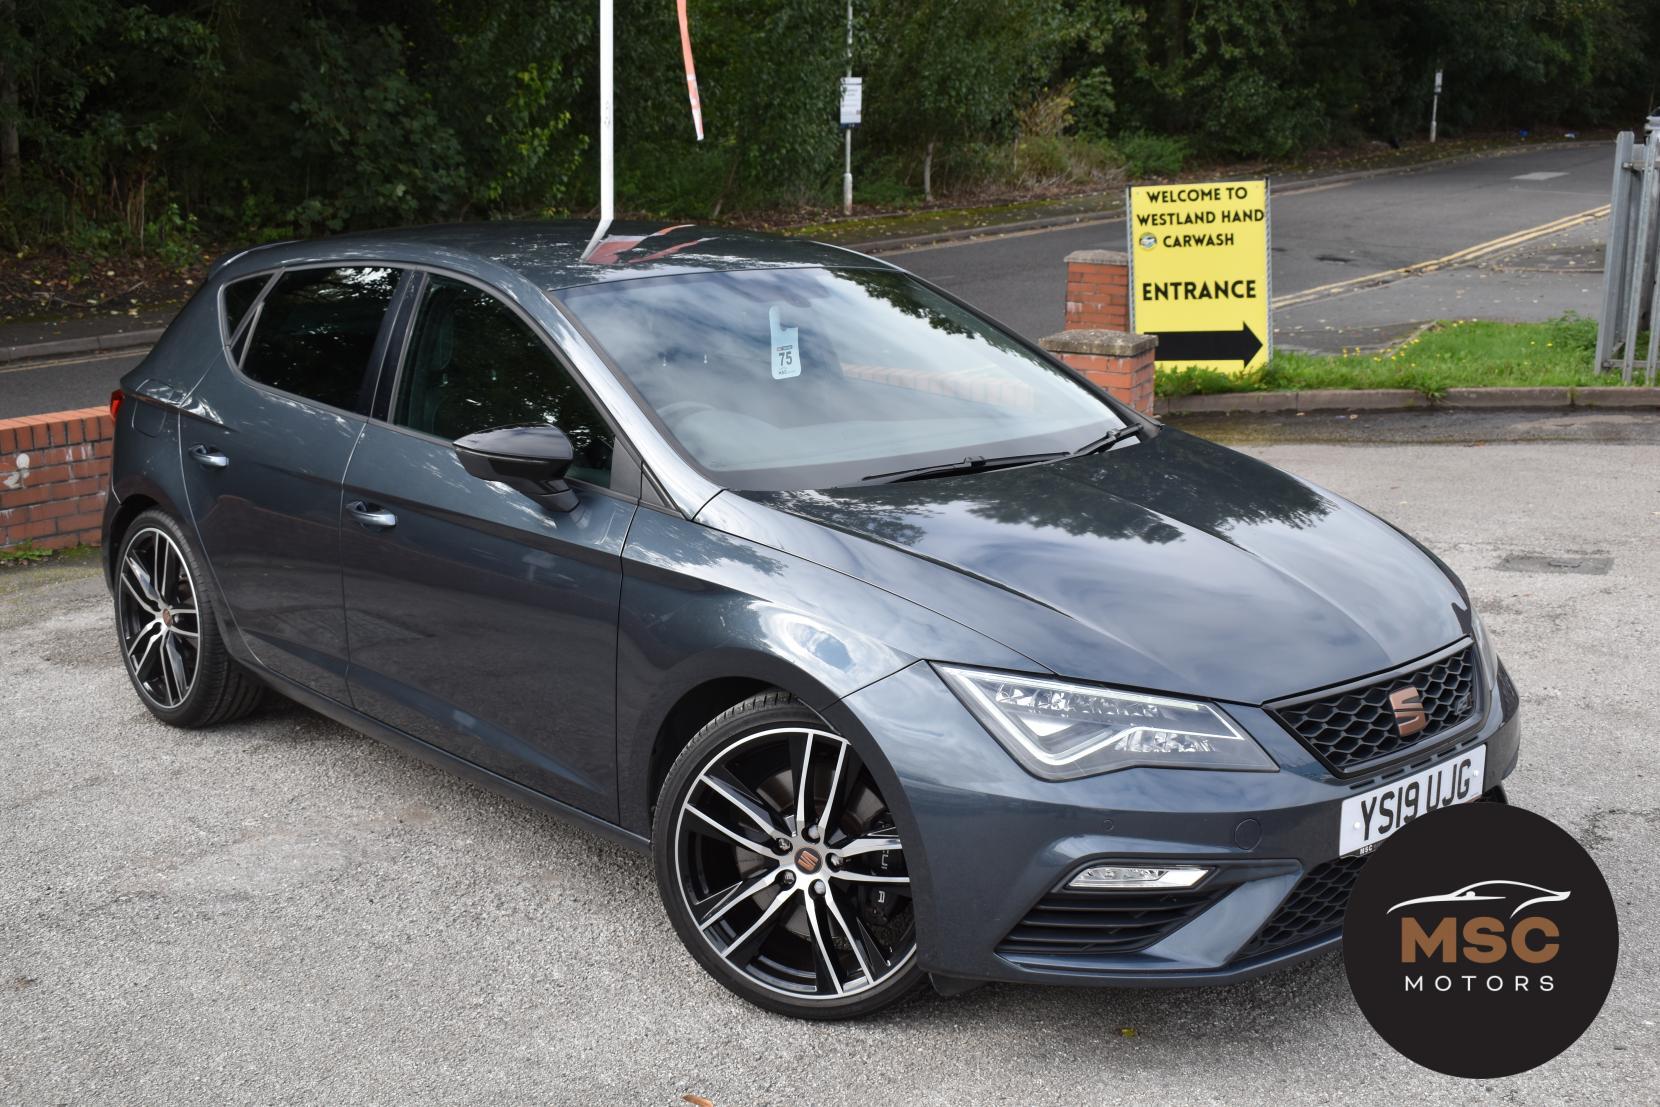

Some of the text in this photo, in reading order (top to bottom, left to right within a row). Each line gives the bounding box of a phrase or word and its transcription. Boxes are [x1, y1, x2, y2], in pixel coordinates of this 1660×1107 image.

[1147, 187, 1248, 203] WELCOME TO
[1137, 209, 1264, 226] WESTLAND HAND
[1163, 233, 1235, 248] CARWASH
[1142, 280, 1257, 301] ENTRANCE
[779, 351, 793, 366] 75
[1361, 758, 1472, 841] YS19 UJG
